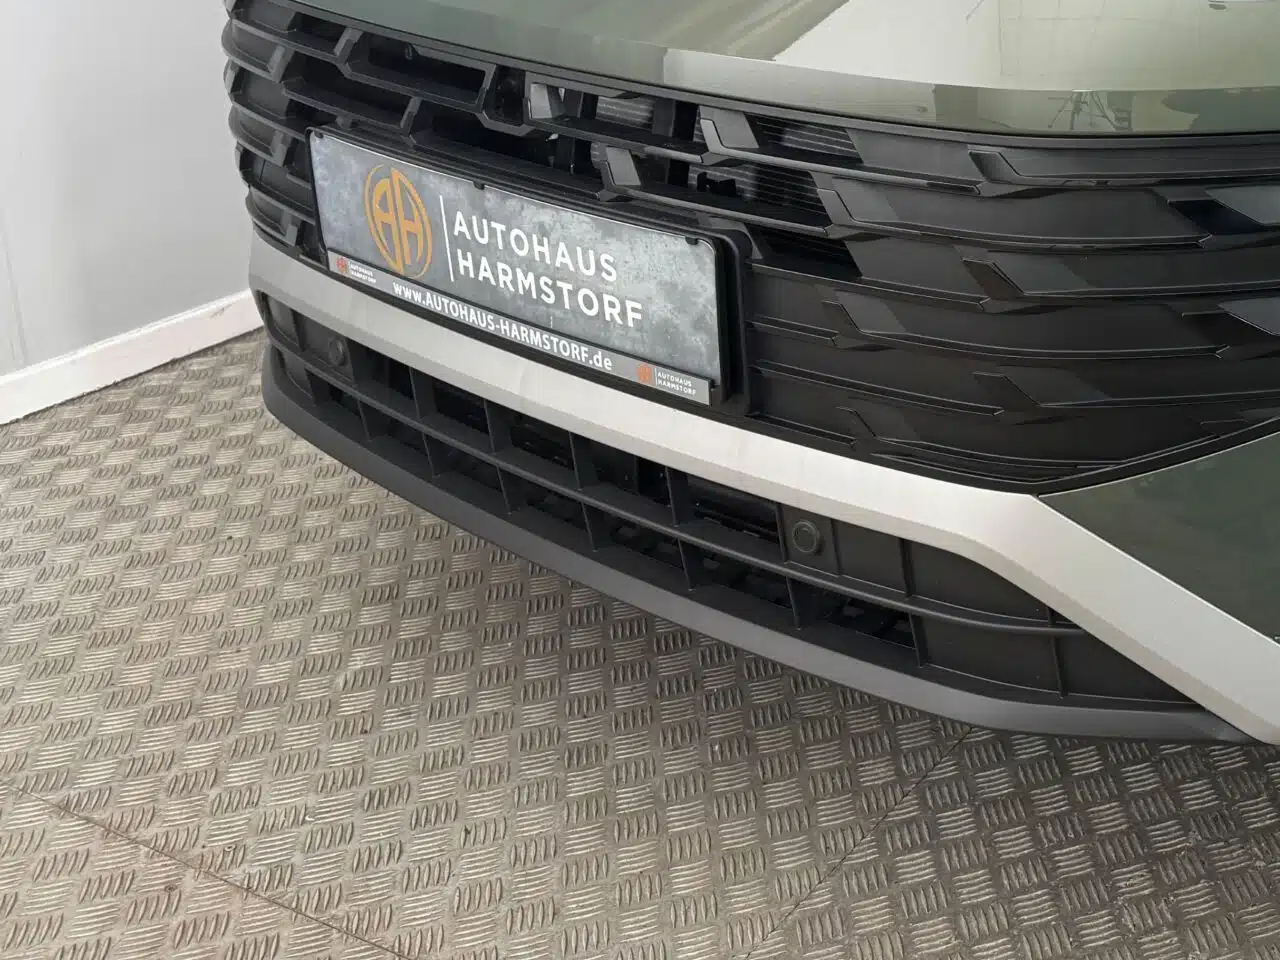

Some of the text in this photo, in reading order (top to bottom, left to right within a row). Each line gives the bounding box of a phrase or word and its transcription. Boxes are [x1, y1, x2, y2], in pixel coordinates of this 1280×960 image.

[453, 210, 618, 283] AUTOHAUS
[455, 247, 644, 329] HARMSTORF
[393, 282, 613, 371] www.AUTOHAUS-HARMSTORF.de
[657, 371, 693, 387] AUTOHAUS
[658, 379, 697, 396] HARMSTORF
